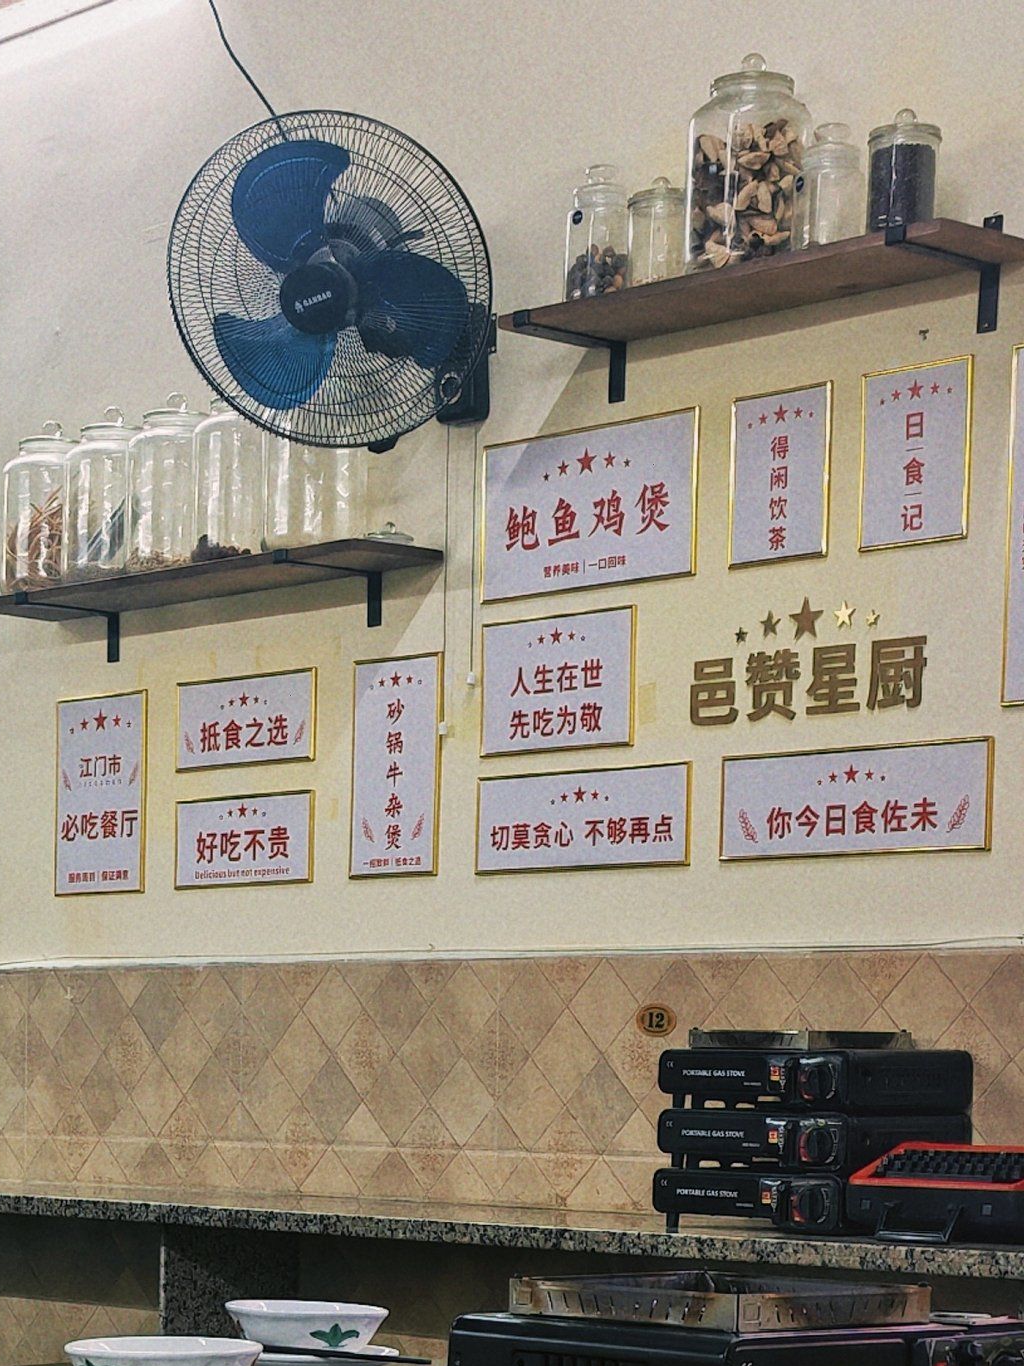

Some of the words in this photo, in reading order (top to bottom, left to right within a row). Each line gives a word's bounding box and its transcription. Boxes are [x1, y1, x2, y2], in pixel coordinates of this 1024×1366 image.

[768, 435, 789, 551] 得闲饮茶
[505, 481, 670, 551] 鲍鱼鸡煲
[510, 658, 603, 697] 人生在世
[689, 634, 928, 726] 邑赞星厨
[200, 713, 289, 753] 抵食之选
[509, 702, 603, 740] 先吃为敬
[79, 754, 122, 778] 江门市
[384, 698, 405, 850] 砂锅牛杂煲
[61, 809, 138, 841] 必吃餐厅
[490, 821, 574, 851] 切莫贪心
[584, 814, 674, 847] 不够再点
[766, 796, 938, 840] 你今日食佐未
[196, 825, 290, 864] 好吃不贵
[194, 869, 227, 880] Delicious
[227, 869, 240, 878] but
[241, 868, 253, 877] not
[253, 866, 290, 877] expensive
[647, 1012, 665, 1029] 12
[682, 1069, 712, 1077] PORTABLE
[713, 1069, 726, 1077] GAS
[681, 1129, 711, 1137] PORTABLE
[711, 1130, 725, 1138] GAS
[725, 1131, 745, 1139] STOVE
[676, 1188, 705, 1197] PORTABLE
[706, 1189, 719, 1197] GAS
